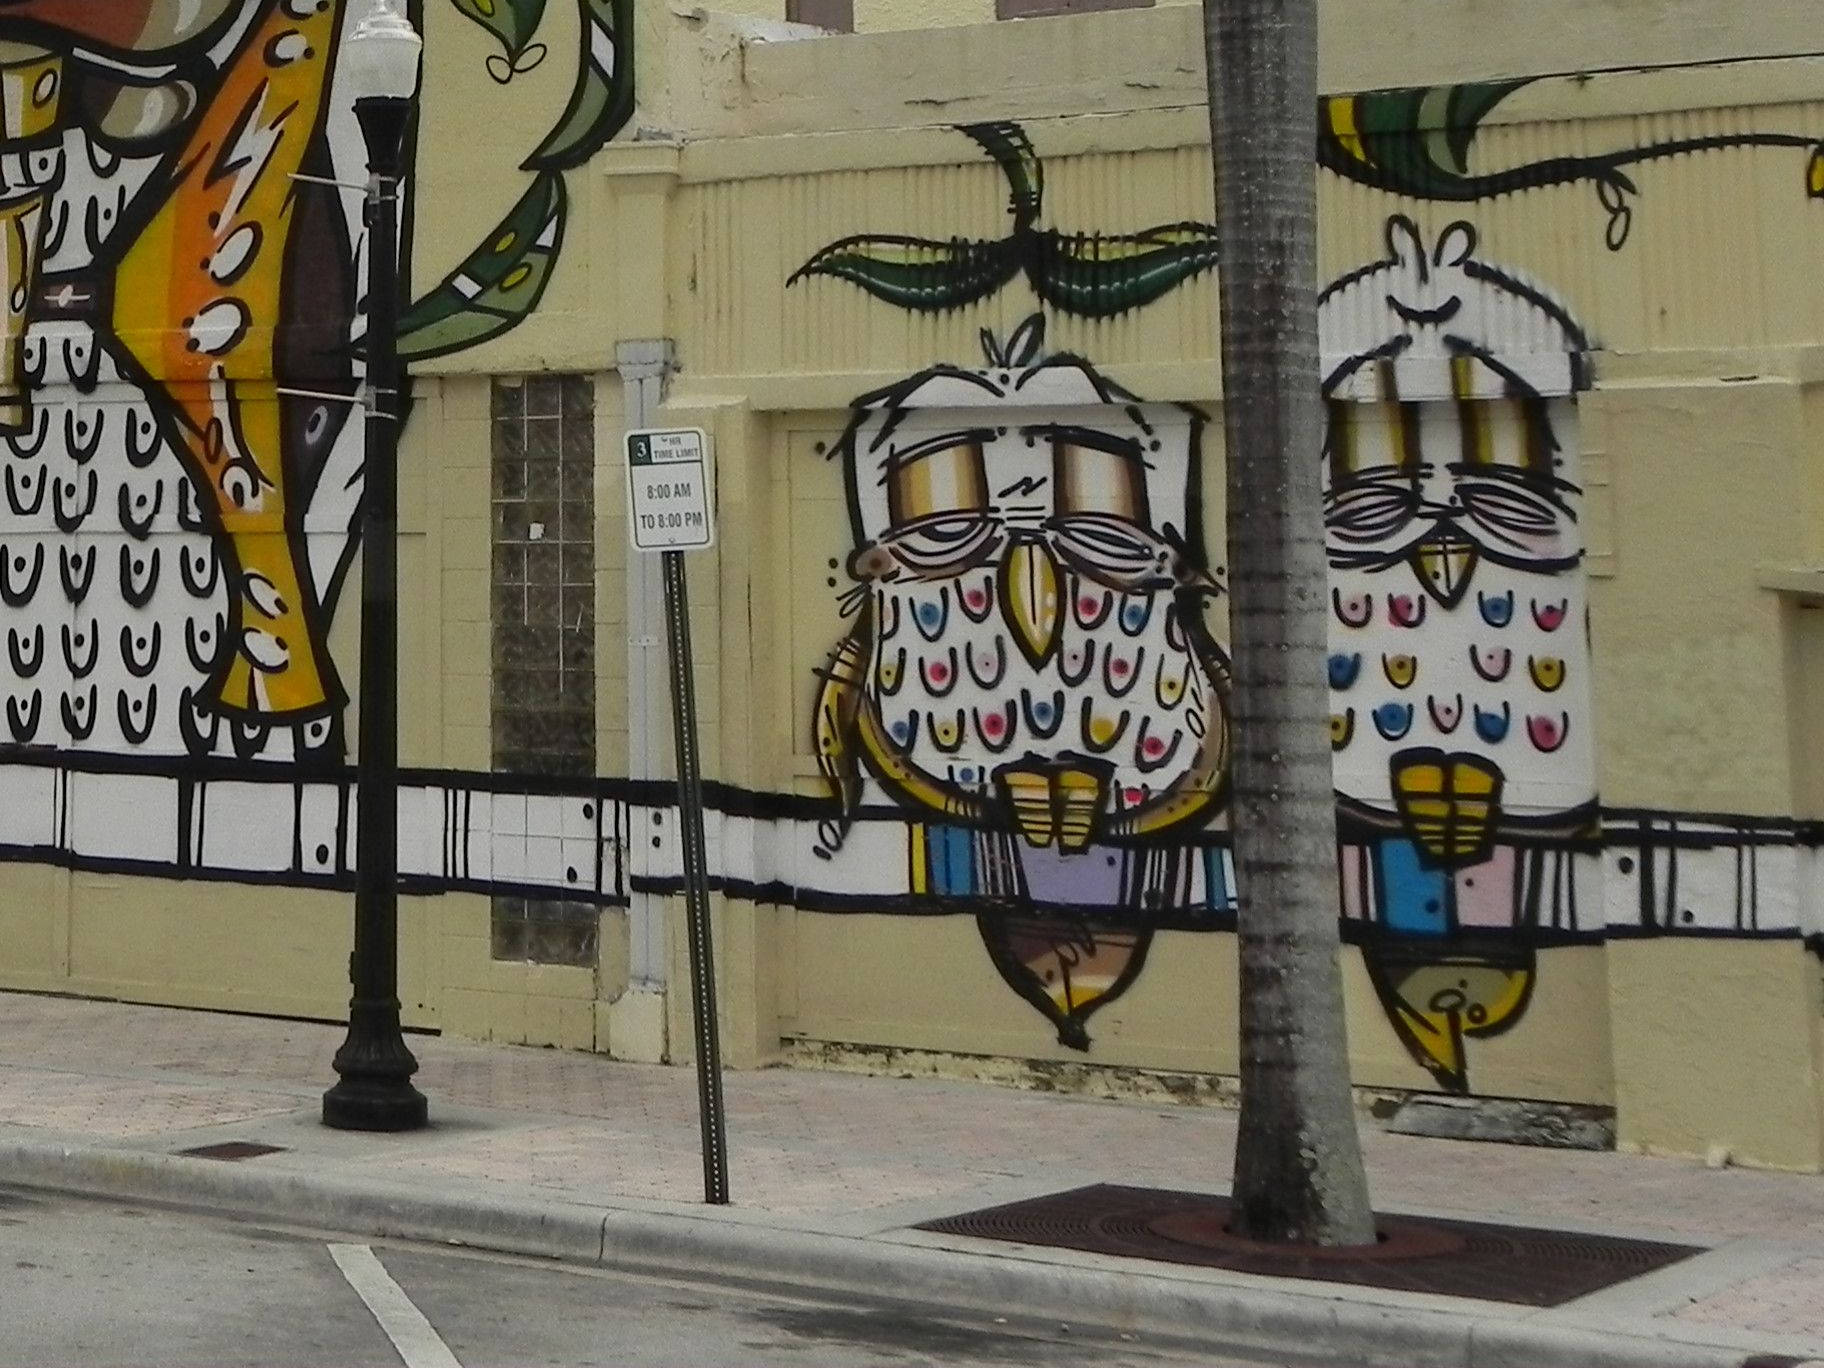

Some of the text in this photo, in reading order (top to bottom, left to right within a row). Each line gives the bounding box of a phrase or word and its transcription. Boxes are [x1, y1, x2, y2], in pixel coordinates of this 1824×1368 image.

[669, 436, 682, 445] HR
[636, 441, 647, 458] 3
[654, 448, 699, 459] TIME LIMIT
[647, 483, 691, 499] 8:00 AM
[640, 512, 703, 529] TO 8:00 PM
